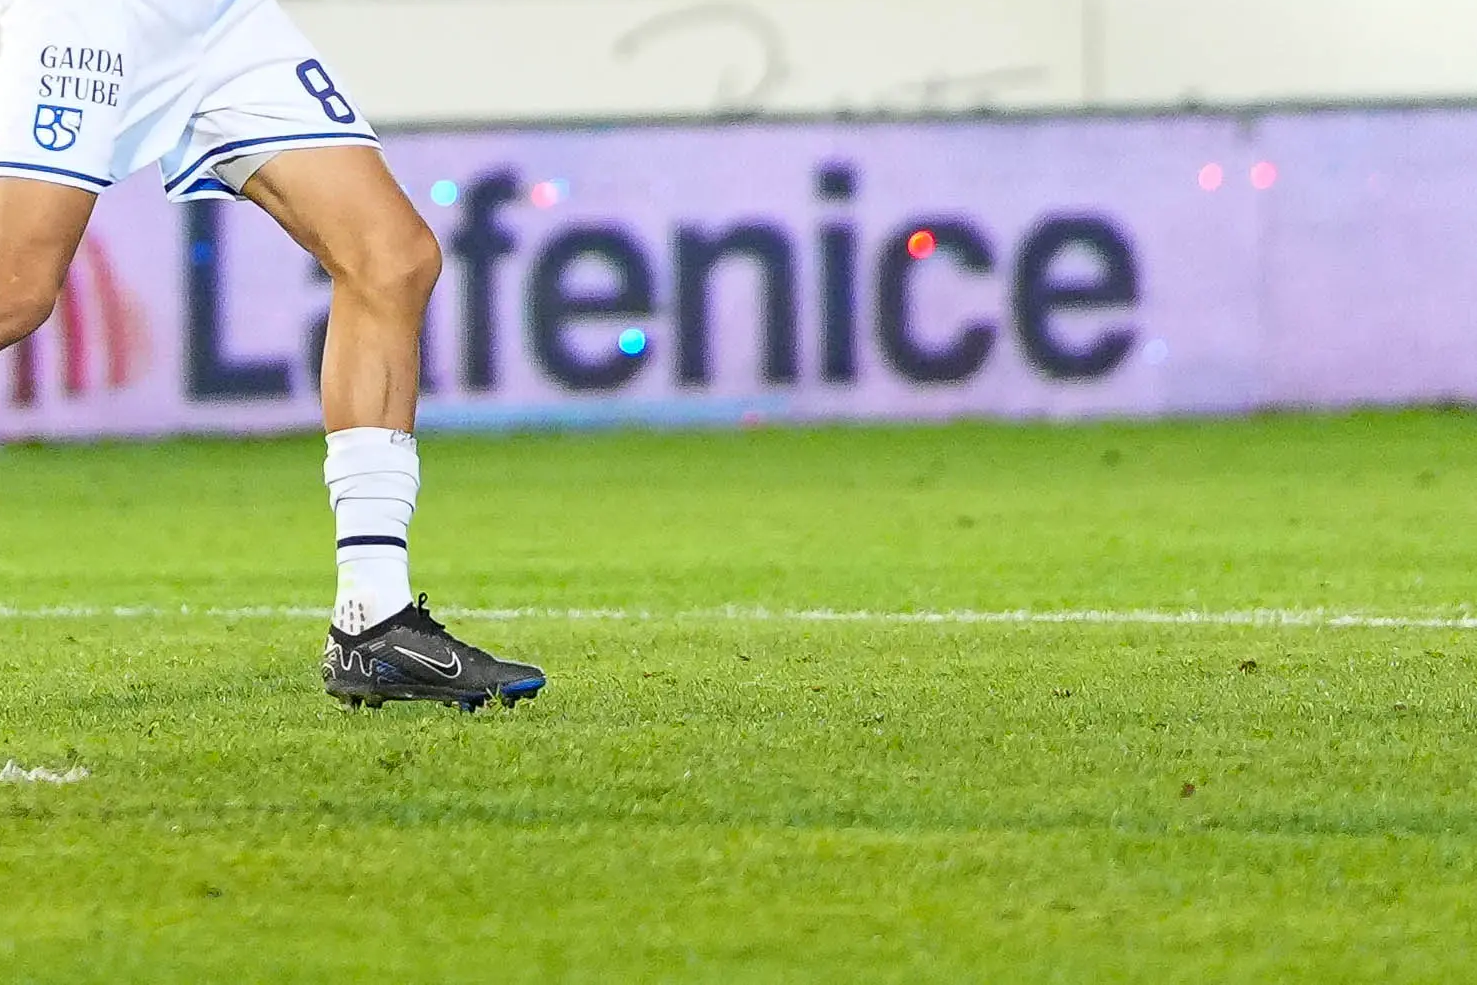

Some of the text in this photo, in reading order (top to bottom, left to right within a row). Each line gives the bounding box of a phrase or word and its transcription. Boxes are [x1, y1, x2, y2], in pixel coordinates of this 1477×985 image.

[40, 44, 124, 78] GARDA
[38, 73, 120, 108] STUBE
[295, 58, 356, 125] 8
[180, 161, 1140, 400] Lfenice
